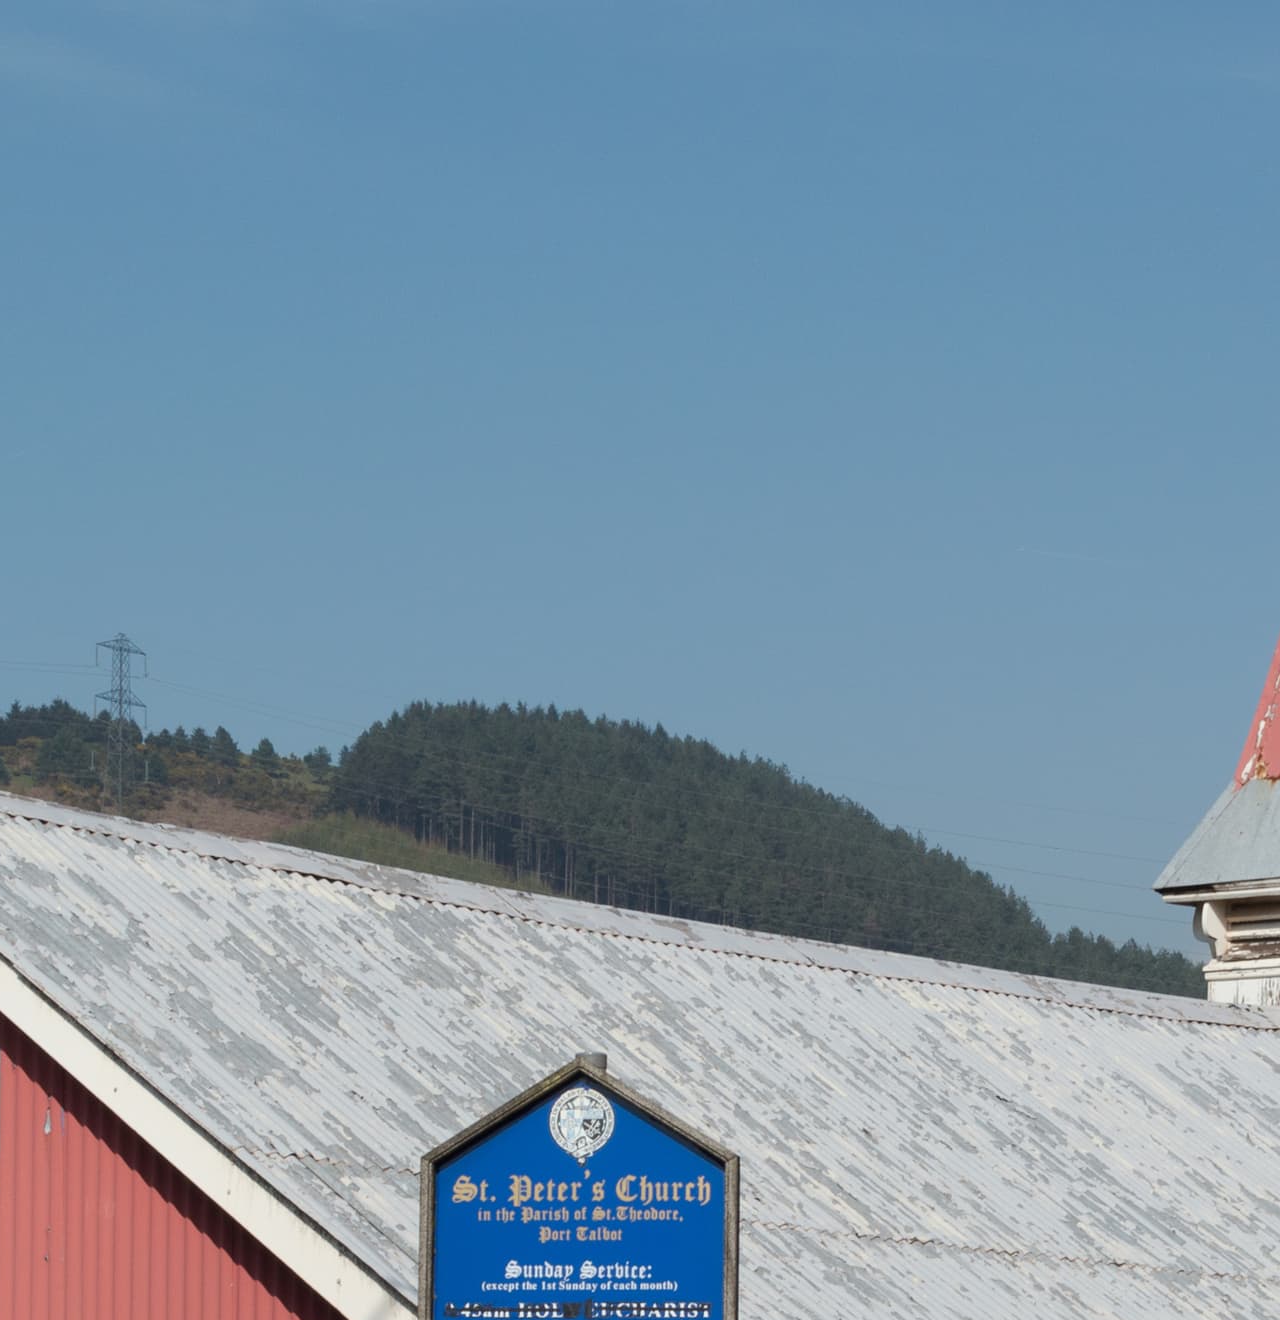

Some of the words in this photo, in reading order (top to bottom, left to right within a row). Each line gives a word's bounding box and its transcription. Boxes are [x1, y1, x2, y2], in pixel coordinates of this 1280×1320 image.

[452, 1175, 496, 1203] St.
[508, 1171, 605, 1206] Peter's
[616, 1174, 711, 1205] Church
[478, 1208, 490, 1221] in
[496, 1208, 515, 1222] the
[520, 1207, 569, 1223] Parish
[574, 1207, 586, 1221] of
[539, 1227, 571, 1242] Port
[576, 1226, 622, 1241] Talbot
[505, 1260, 573, 1283] Sunday
[580, 1261, 651, 1279] Service:
[482, 1281, 518, 1291] (except
[522, 1281, 537, 1290] the
[542, 1281, 556, 1290] 1st
[559, 1281, 597, 1292] Sunday
[600, 1281, 611, 1290] of
[613, 1281, 636, 1290] each
[640, 1281, 677, 1291] month)
